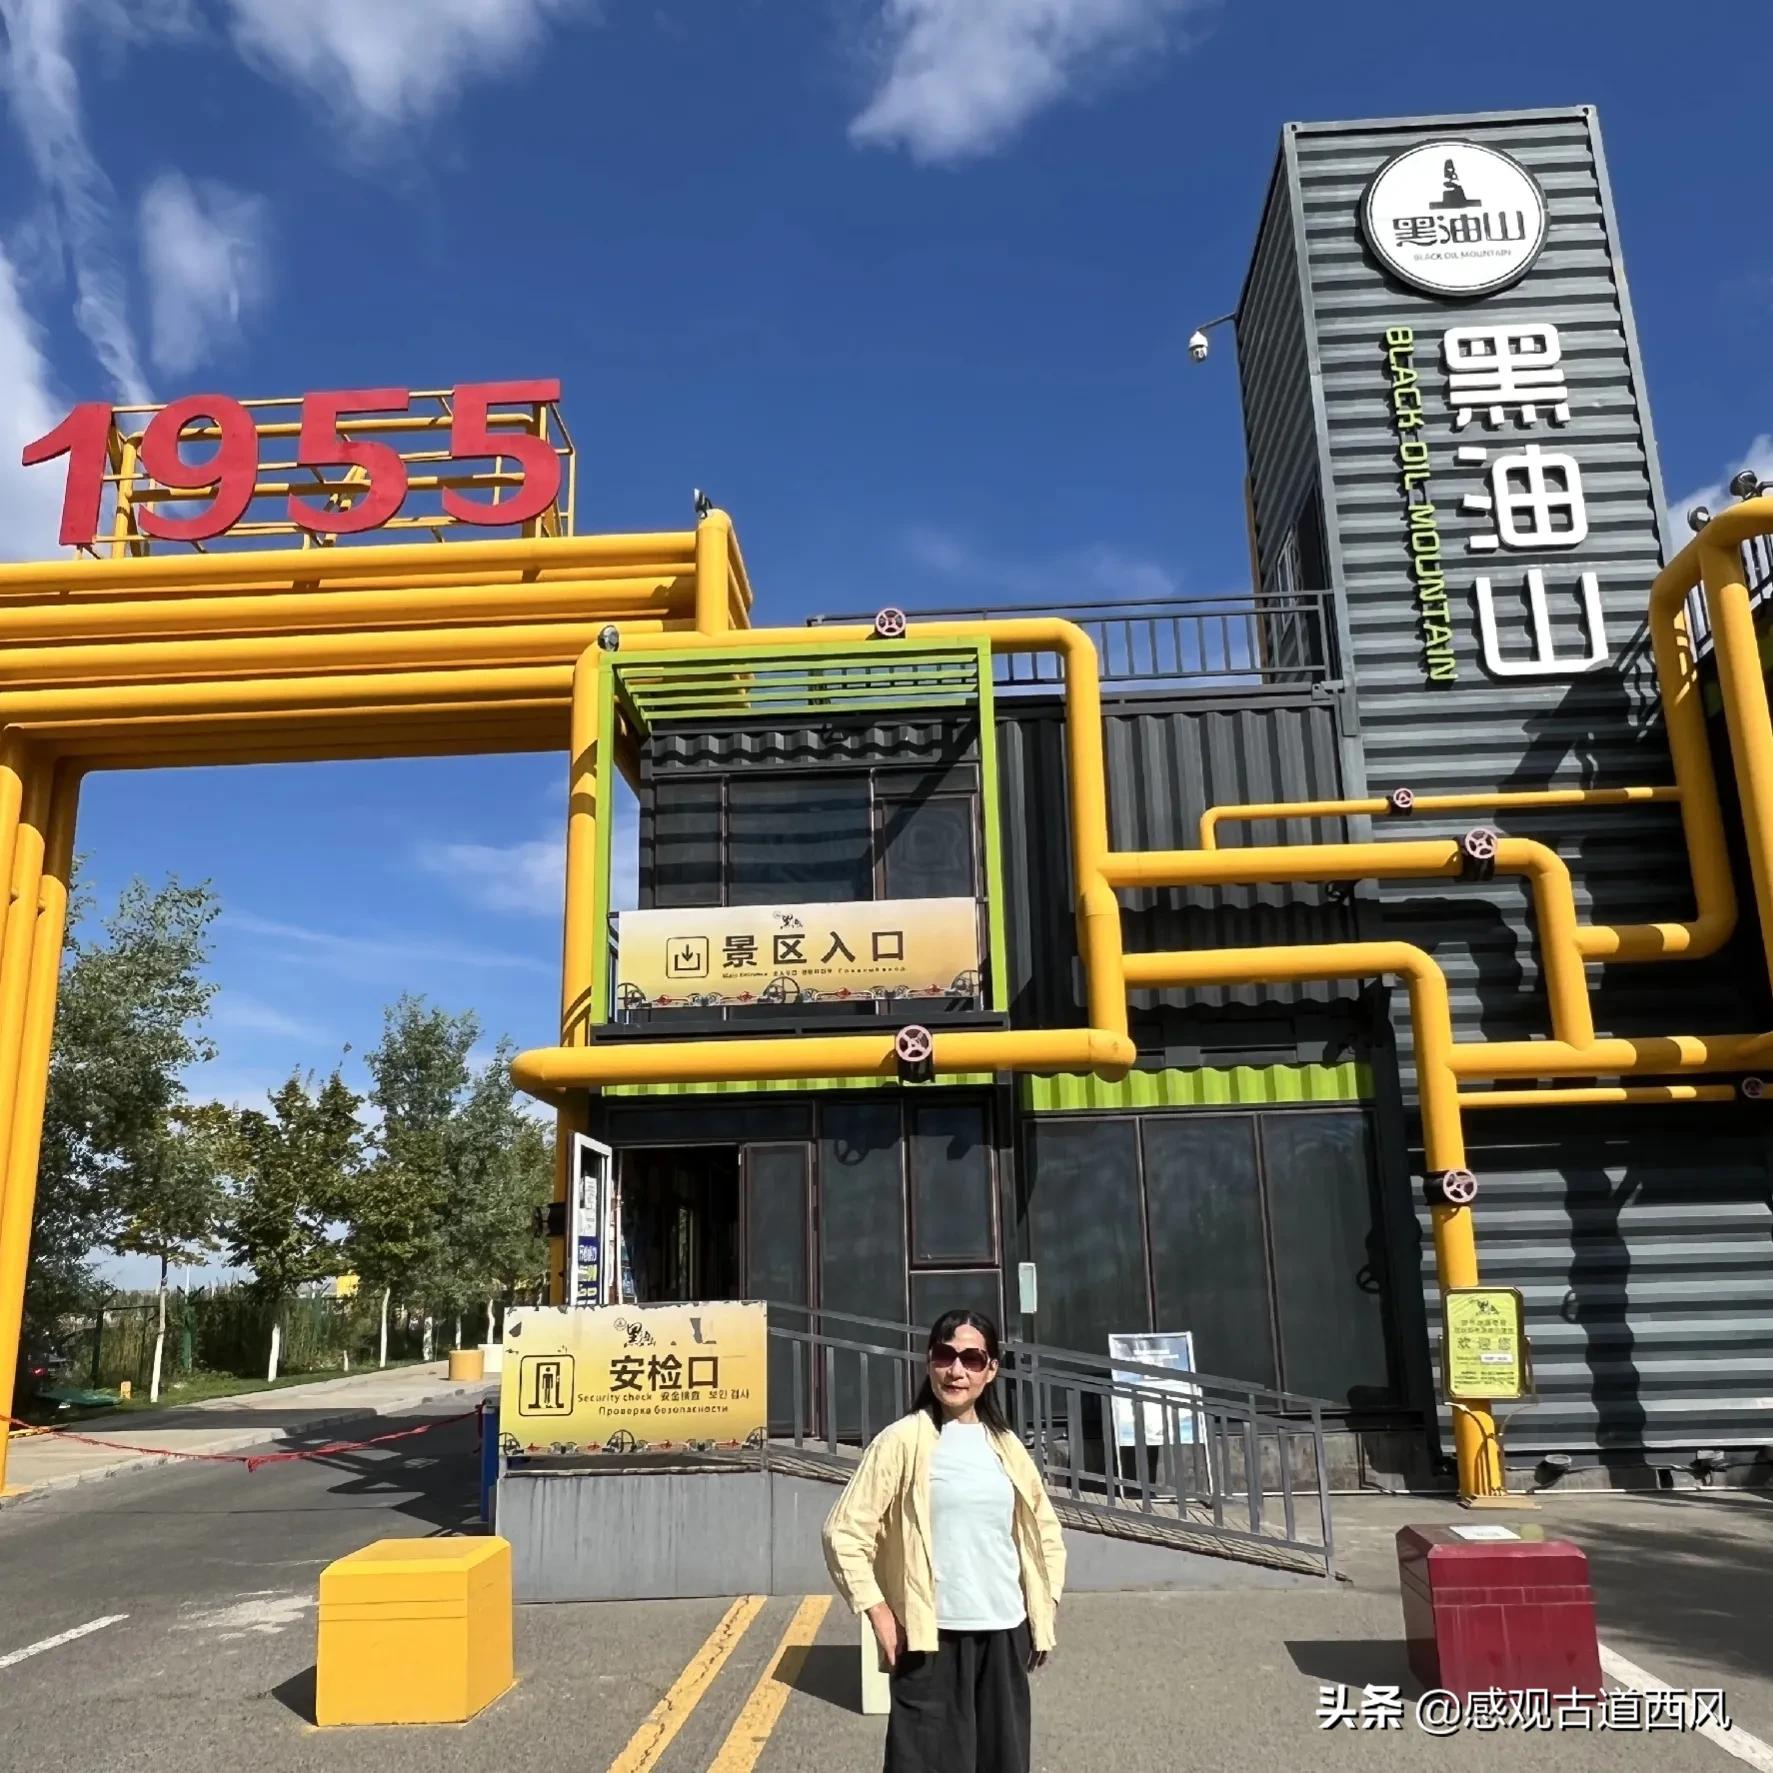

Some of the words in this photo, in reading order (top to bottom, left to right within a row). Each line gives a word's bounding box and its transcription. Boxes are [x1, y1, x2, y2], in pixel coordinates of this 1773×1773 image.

[1393, 211, 1526, 247] 黑油山
[1386, 326, 1425, 429] BLACK
[22, 378, 561, 546] 1955
[1400, 441, 1431, 490] OIL
[1444, 323, 1609, 676] 黑油山
[1408, 503, 1460, 682] MOUNTAIN
[722, 930, 904, 968] 景区入口
[609, 1353, 719, 1392] 安检口
[577, 1393, 620, 1404] Security
[623, 1392, 652, 1402] check
[599, 1406, 651, 1416] Проверка
[654, 1404, 729, 1415] безопасности
